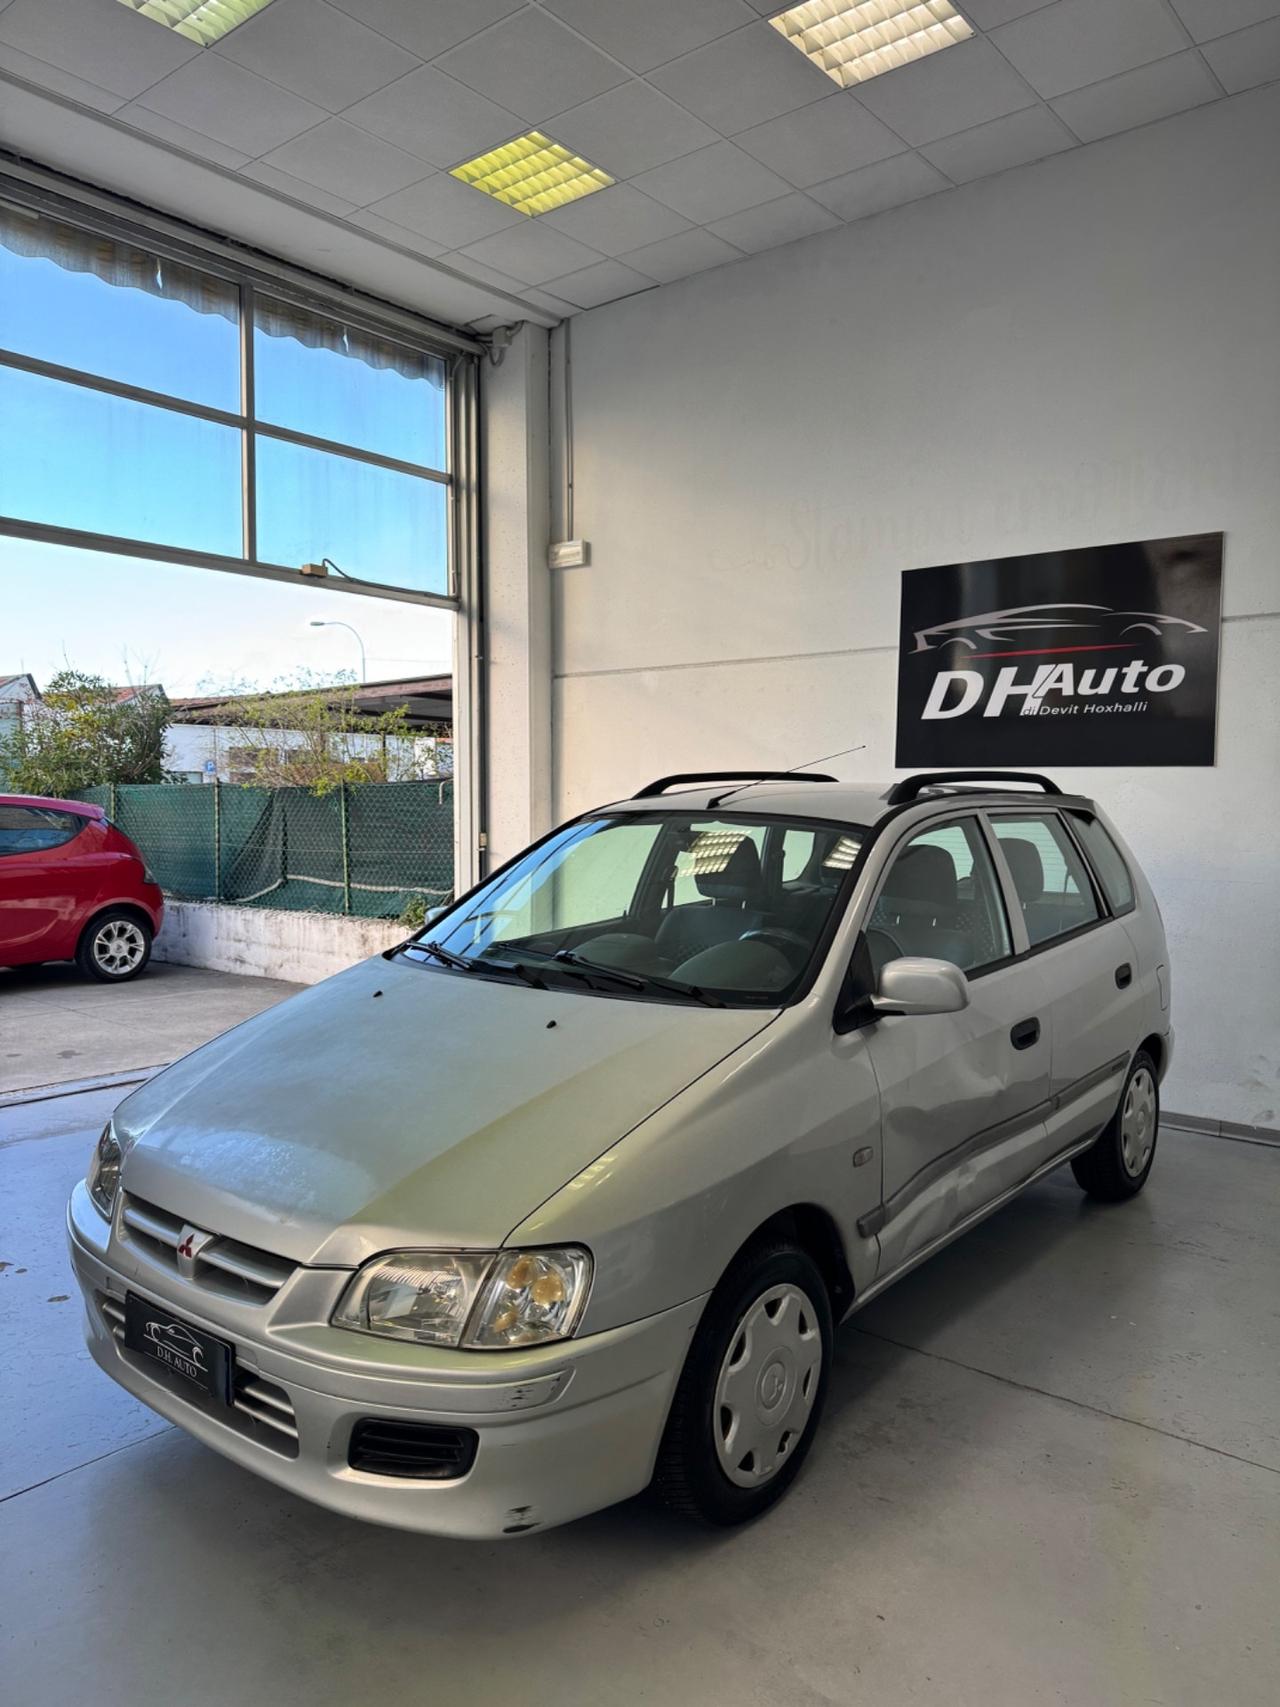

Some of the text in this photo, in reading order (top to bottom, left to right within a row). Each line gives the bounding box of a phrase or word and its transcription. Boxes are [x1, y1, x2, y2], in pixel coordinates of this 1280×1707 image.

[1039, 704, 1079, 716] Devit
[1083, 701, 1149, 714] Hoxhalli
[174, 1357, 198, 1377] AUTO
